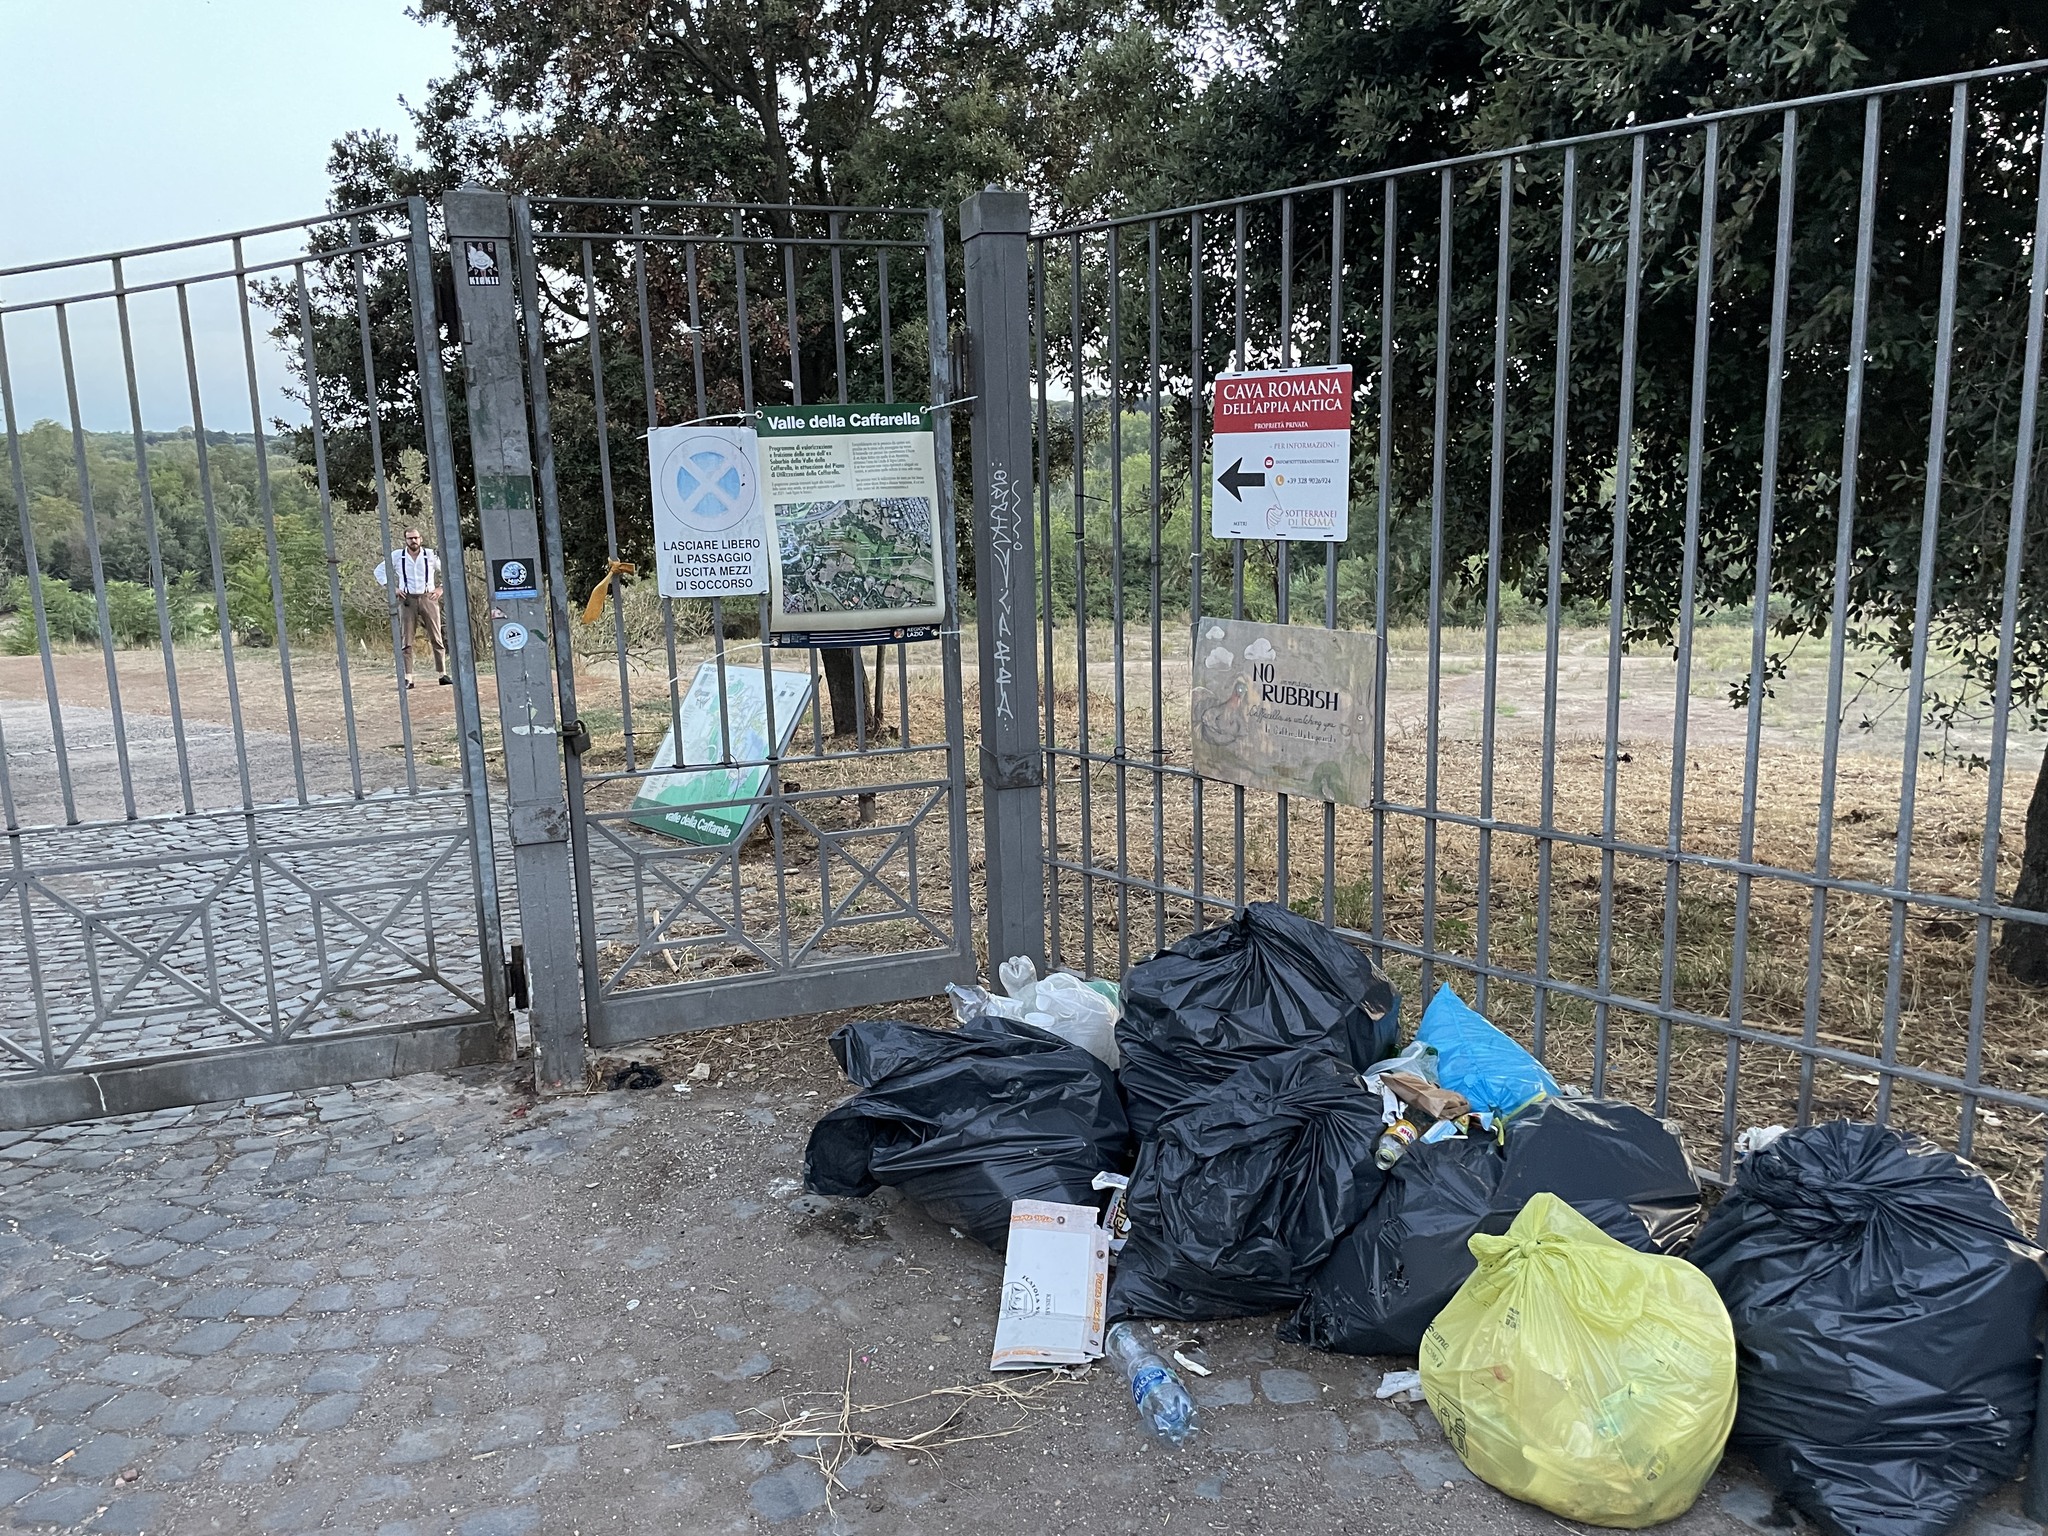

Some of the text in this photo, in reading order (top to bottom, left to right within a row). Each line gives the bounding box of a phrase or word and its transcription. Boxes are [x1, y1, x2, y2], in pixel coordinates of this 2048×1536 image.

[1223, 378, 1343, 400] CAVA ROMANA
[1223, 398, 1343, 416] DELL'APPIA ANTICA
[767, 412, 921, 430] Valle della Caffarella
[1274, 441, 1336, 450] PER INFORMAZIONI
[1285, 509, 1338, 518] SOTTERRANEI
[1288, 516, 1335, 527] DI ROMA
[663, 538, 761, 551] LASCIARE LIBERO
[673, 552, 753, 564] IL PASSAGGIO
[676, 565, 752, 577] USCITA MEZZI
[676, 578, 753, 591] DI SOCCORSO
[906, 630, 924, 638] LAZIO
[1252, 663, 1275, 684] NO
[1262, 683, 1339, 711] RUBBISH
[680, 814, 698, 829] della
[697, 818, 732, 838] Caffarella
